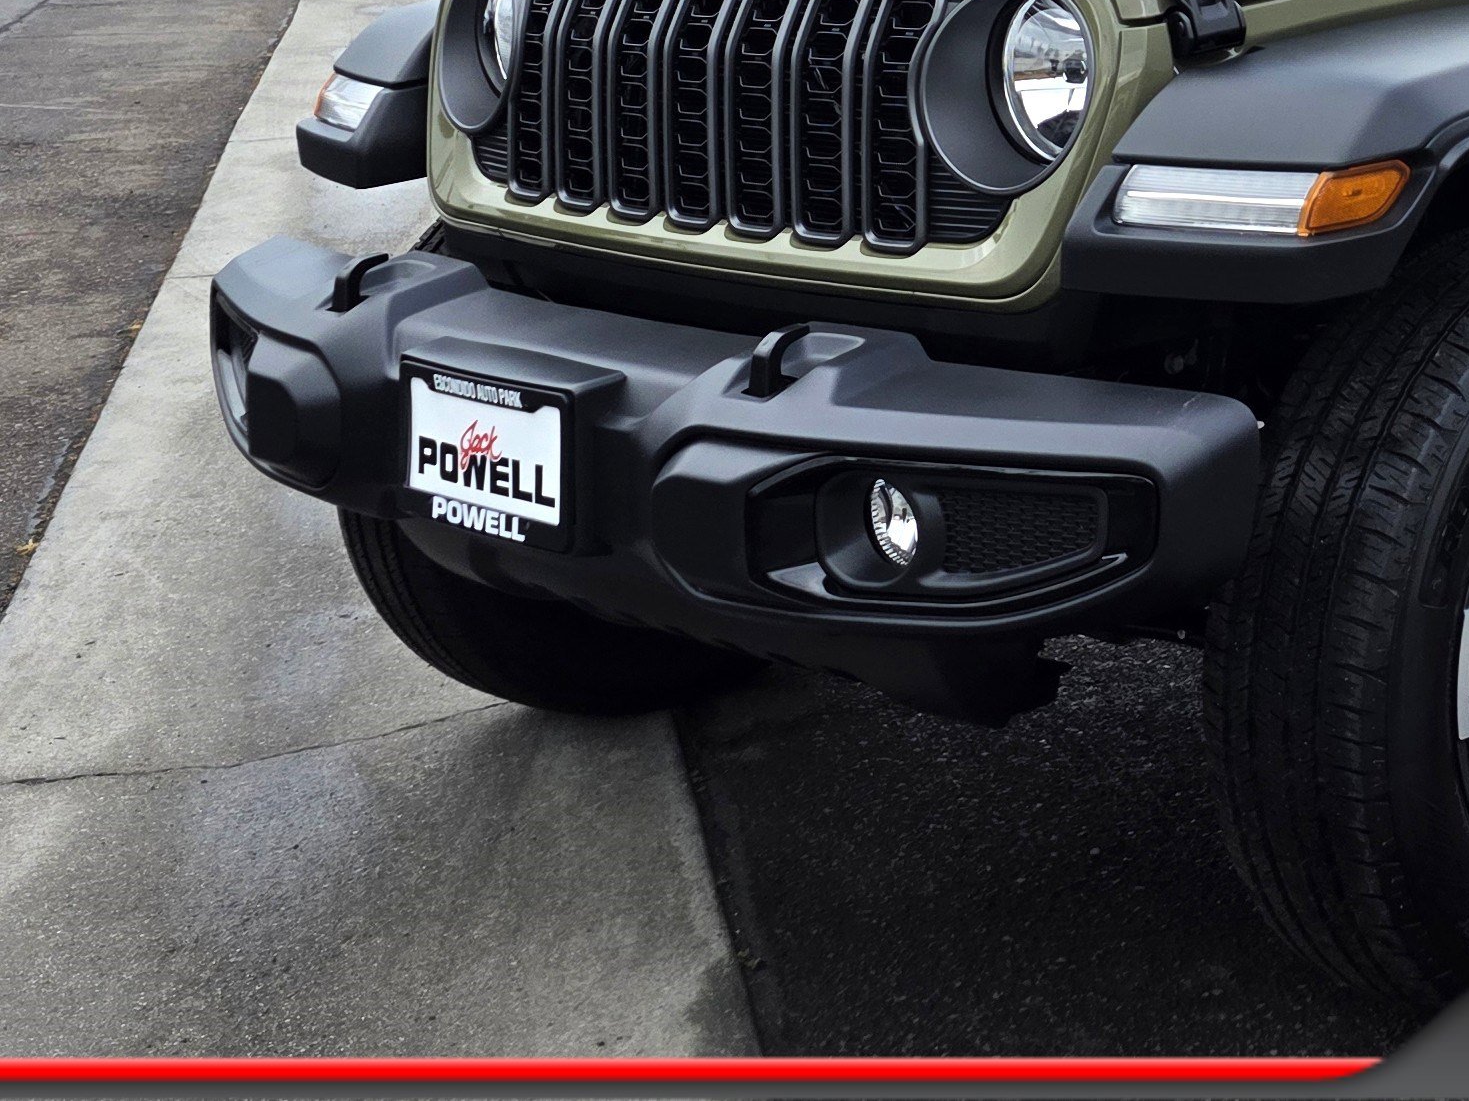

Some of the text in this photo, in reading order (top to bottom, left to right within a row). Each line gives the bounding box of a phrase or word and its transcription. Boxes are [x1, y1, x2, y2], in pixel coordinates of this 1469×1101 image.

[433, 373, 523, 409] ESCONDIDO AUTO PARK
[460, 419, 503, 473] Jack
[418, 435, 556, 509] POWELL
[431, 495, 526, 543] POWELL
